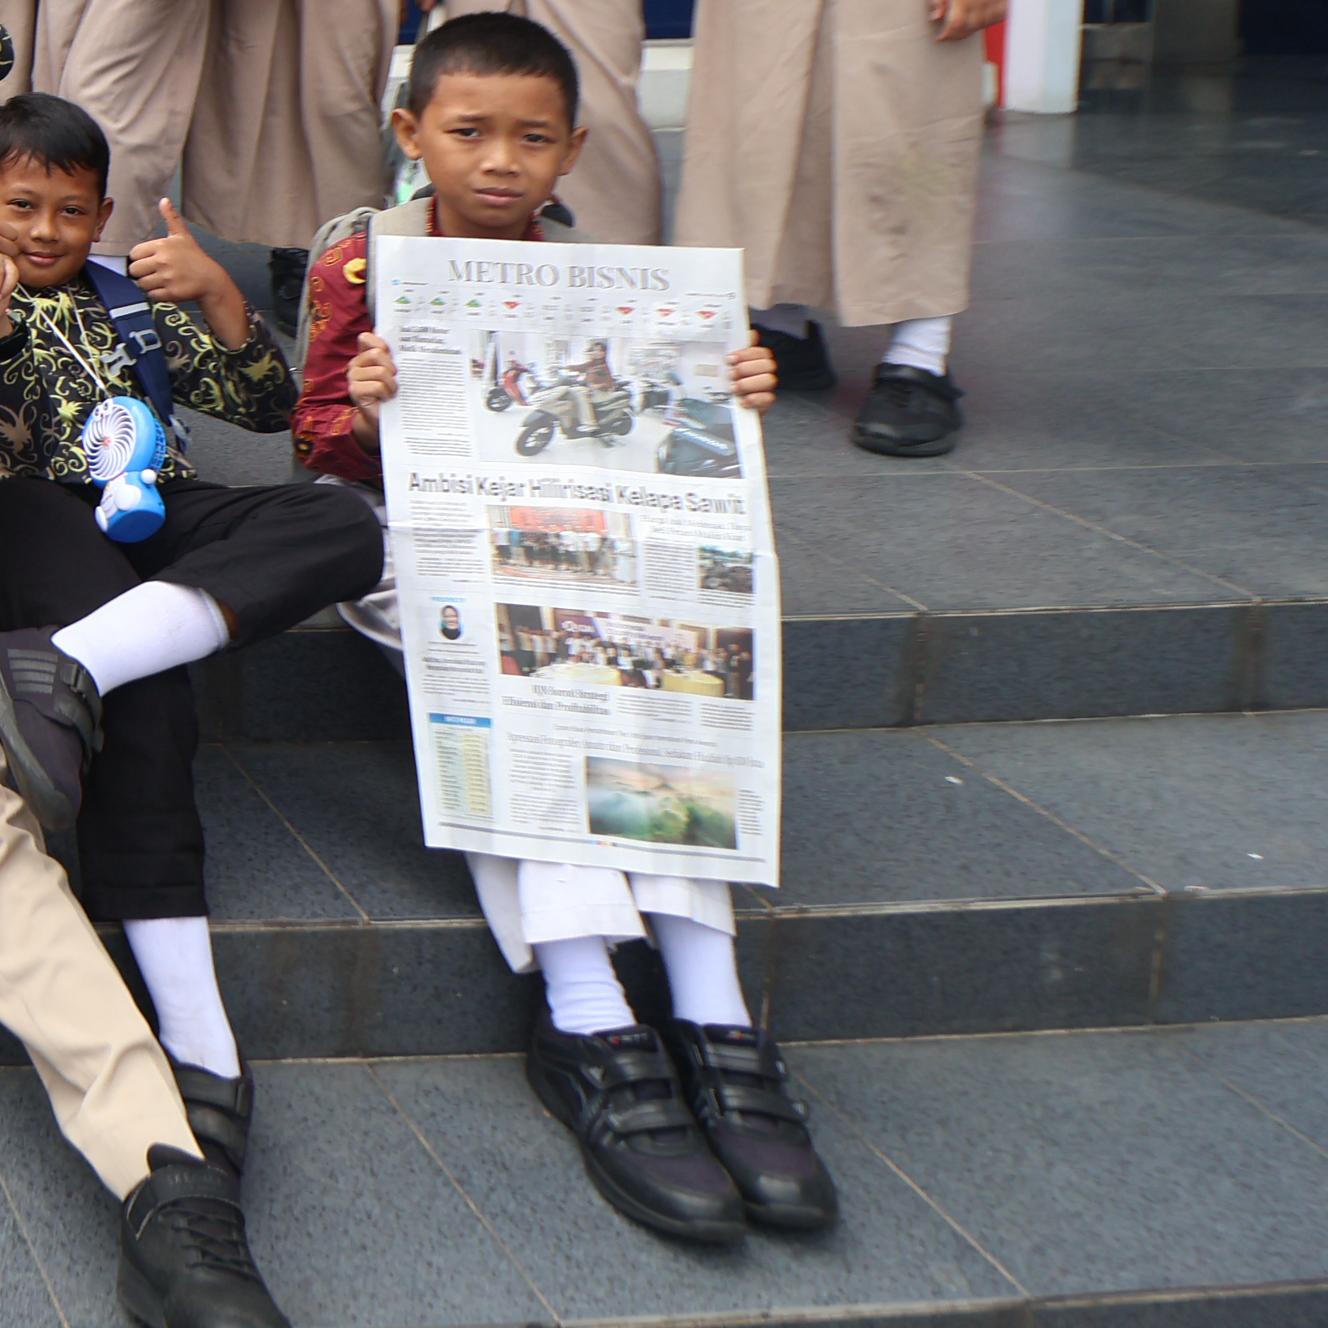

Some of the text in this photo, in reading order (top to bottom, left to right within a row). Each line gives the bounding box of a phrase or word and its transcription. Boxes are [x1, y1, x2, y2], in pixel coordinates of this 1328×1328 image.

[447, 259, 671, 292] METRO BISNIS
[409, 472, 474, 494] Ambisi
[476, 476, 525, 501] Kejar
[615, 485, 682, 513] Kelapa
[684, 492, 747, 515] Sawit
